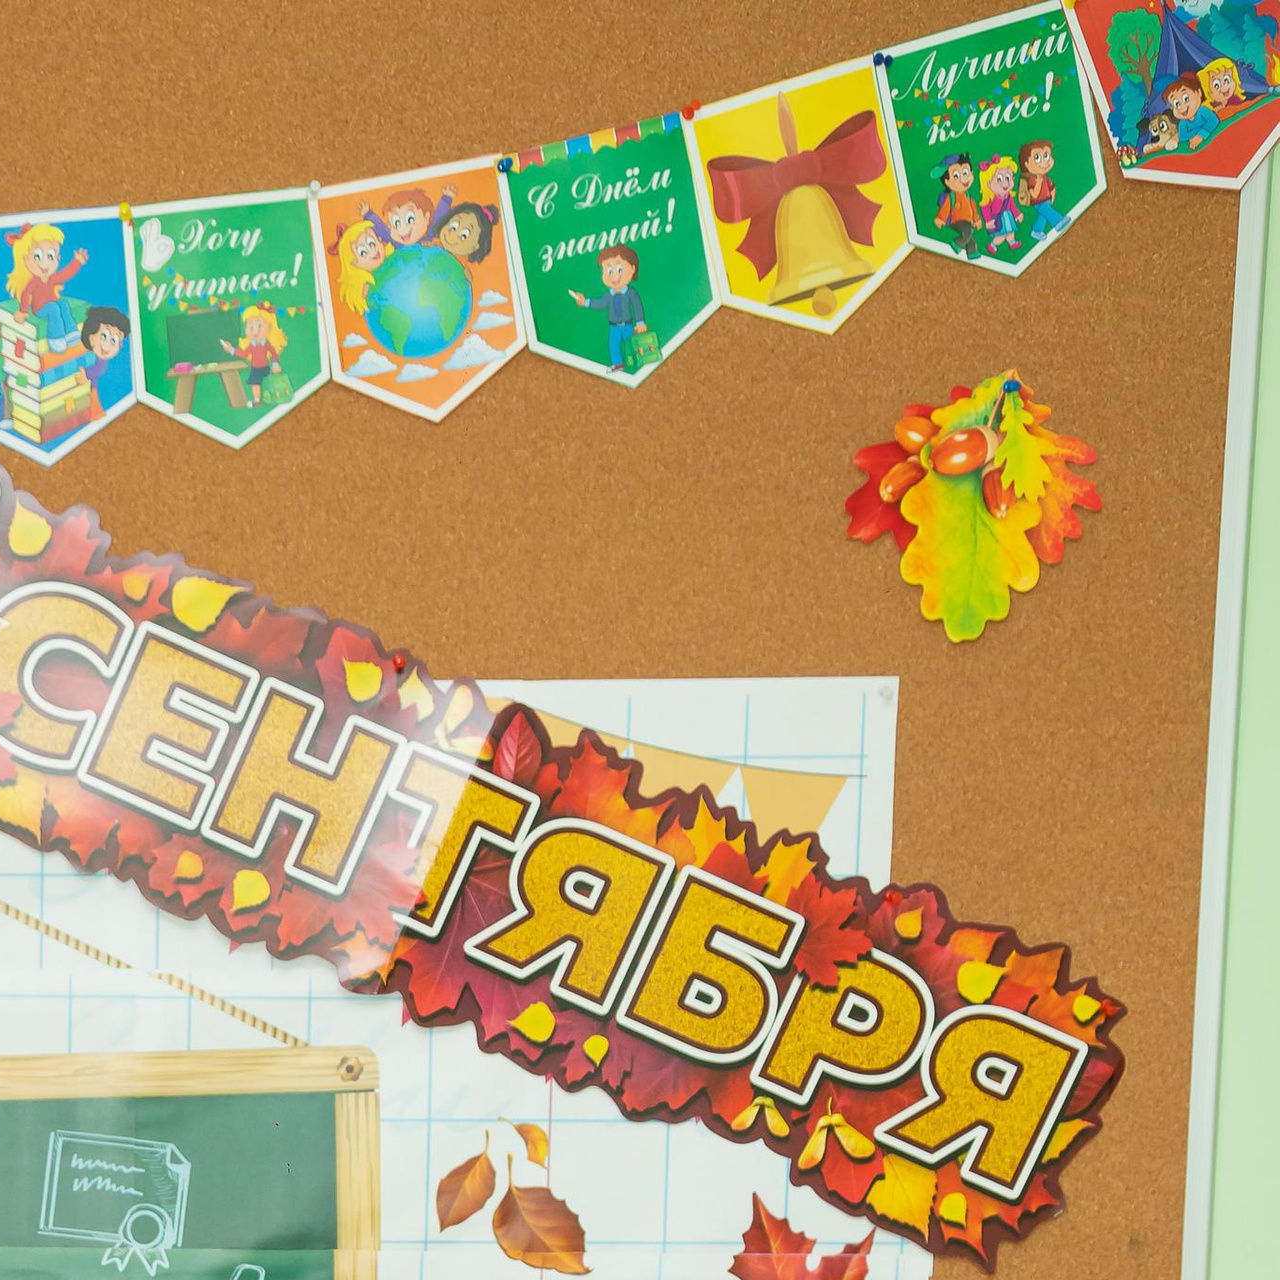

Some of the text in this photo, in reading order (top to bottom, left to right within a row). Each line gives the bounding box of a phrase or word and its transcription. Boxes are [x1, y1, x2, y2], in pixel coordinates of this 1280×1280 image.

[891, 20, 1070, 101] Лучший
[926, 71, 1055, 146] класс!
[571, 166, 672, 210] Днём
[177, 218, 263, 257] Хочу
[538, 197, 676, 272] знаний!
[146, 252, 304, 312] учиться!
